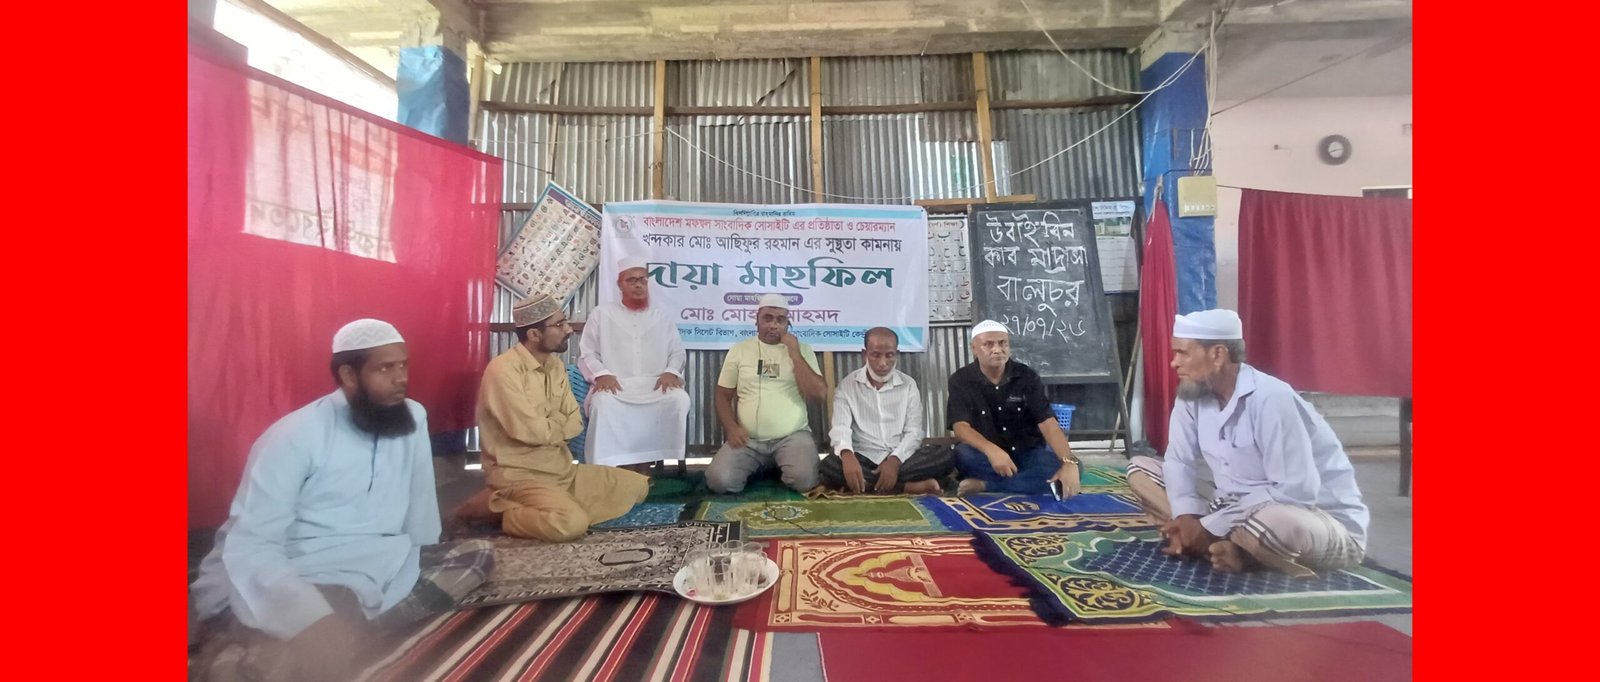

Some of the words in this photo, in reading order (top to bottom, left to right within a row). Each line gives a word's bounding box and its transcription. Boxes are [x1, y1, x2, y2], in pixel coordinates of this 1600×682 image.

[643, 216, 683, 228] বাংলাদেশ
[714, 217, 752, 231] সাংবাদিক
[755, 218, 790, 231] সোসাইটি
[792, 222, 805, 231] এর
[808, 217, 844, 232] প্রতিষ্ঠাতা
[847, 221, 854, 231] ও
[856, 221, 896, 232] চেয়ারম্যান
[643, 233, 685, 248] খন্দকার
[689, 235, 711, 249] মোঃ
[715, 233, 760, 254] আছিফুর
[764, 237, 800, 250] রহমান
[804, 238, 822, 250] এর
[646, 260, 723, 291] দায়া
[736, 256, 894, 290] মাহফিল
[681, 306, 714, 321] মোঃ
